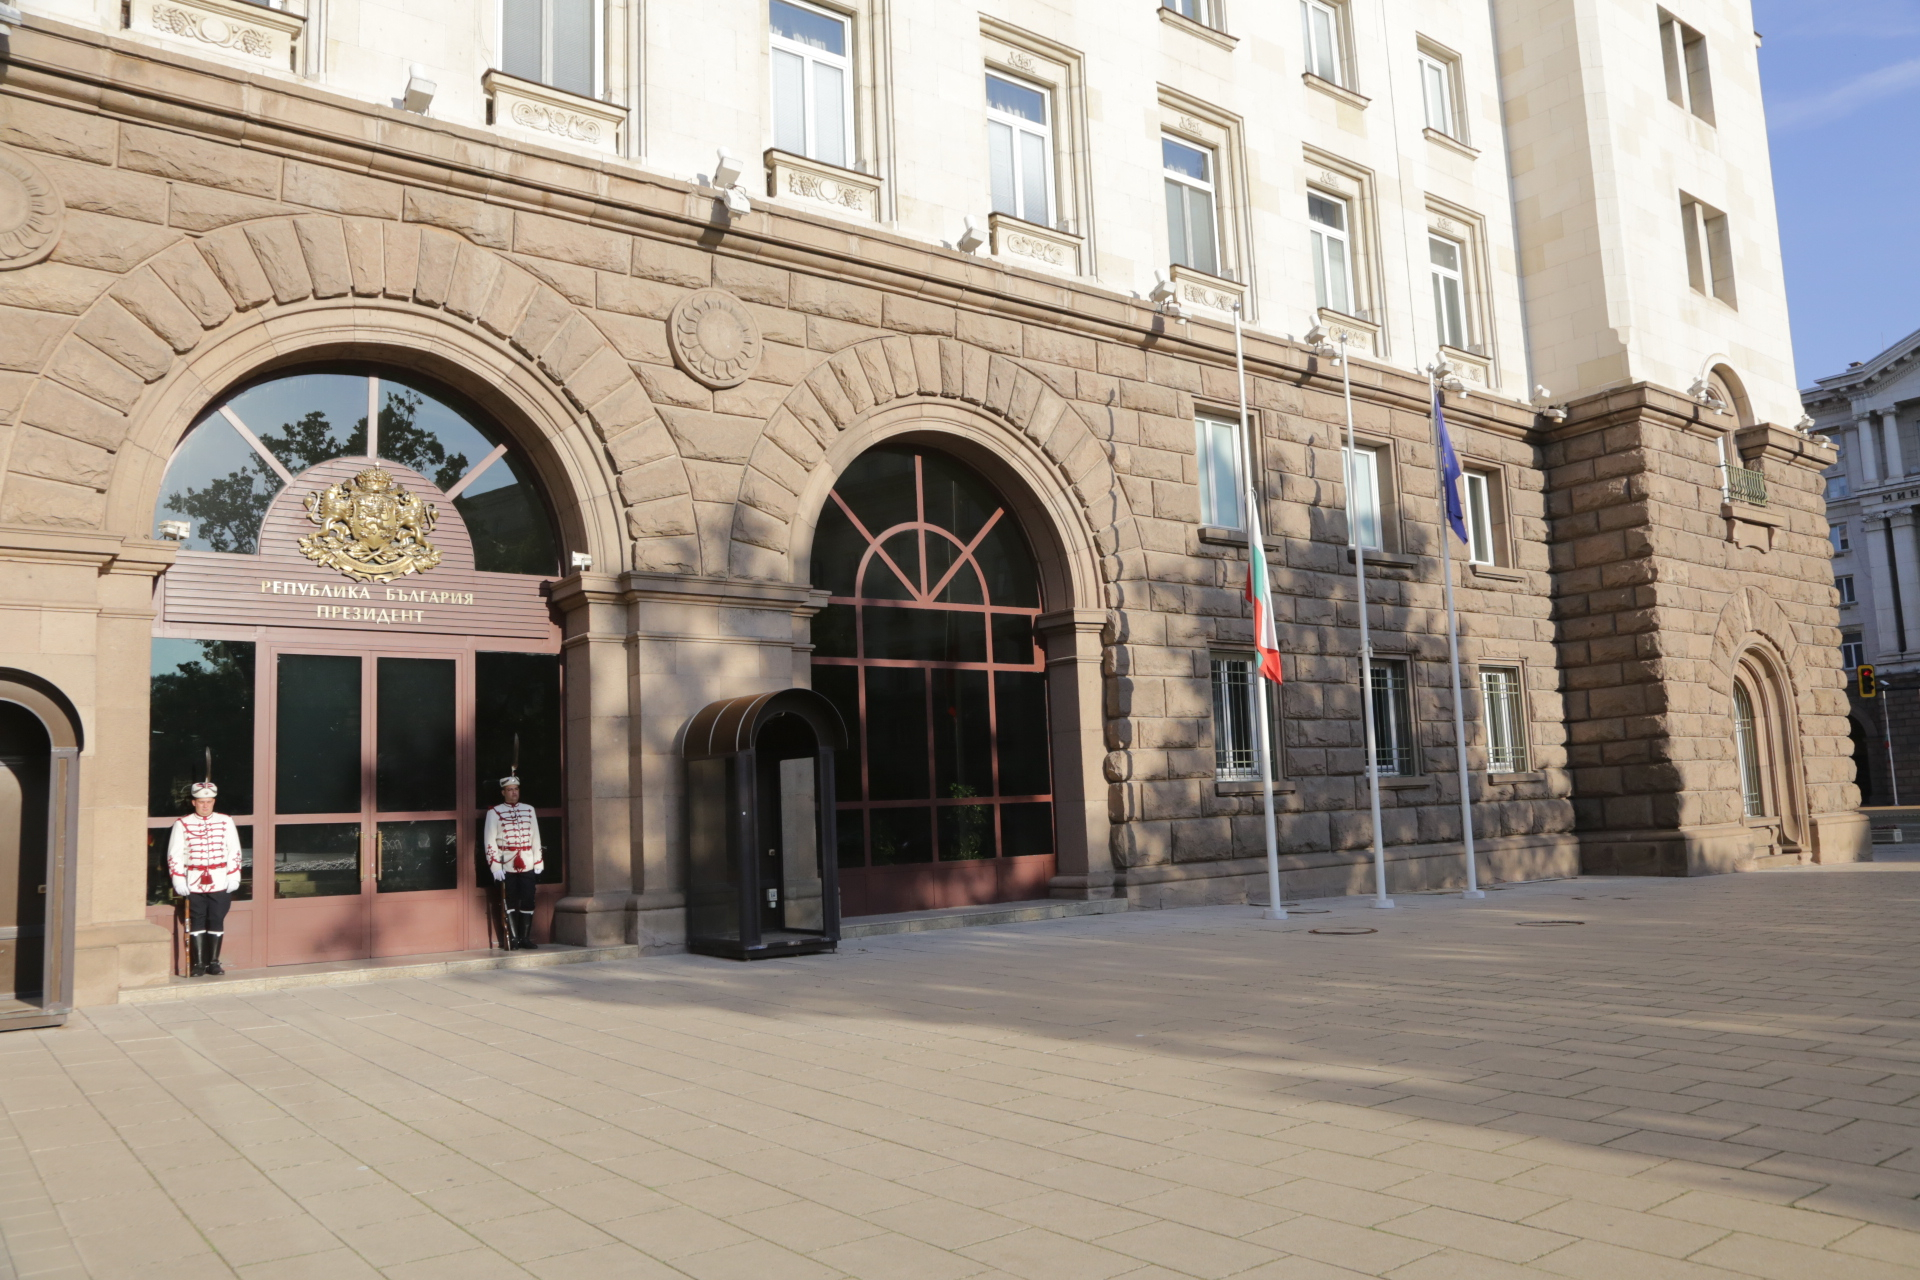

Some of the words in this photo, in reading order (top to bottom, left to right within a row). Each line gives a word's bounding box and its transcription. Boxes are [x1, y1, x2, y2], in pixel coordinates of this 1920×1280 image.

[261, 580, 371, 599] РЕПУБЛИКА
[386, 588, 474, 605] БЪЛГАРИЯ
[317, 605, 424, 624] ПРЕЗИДЕНТ
